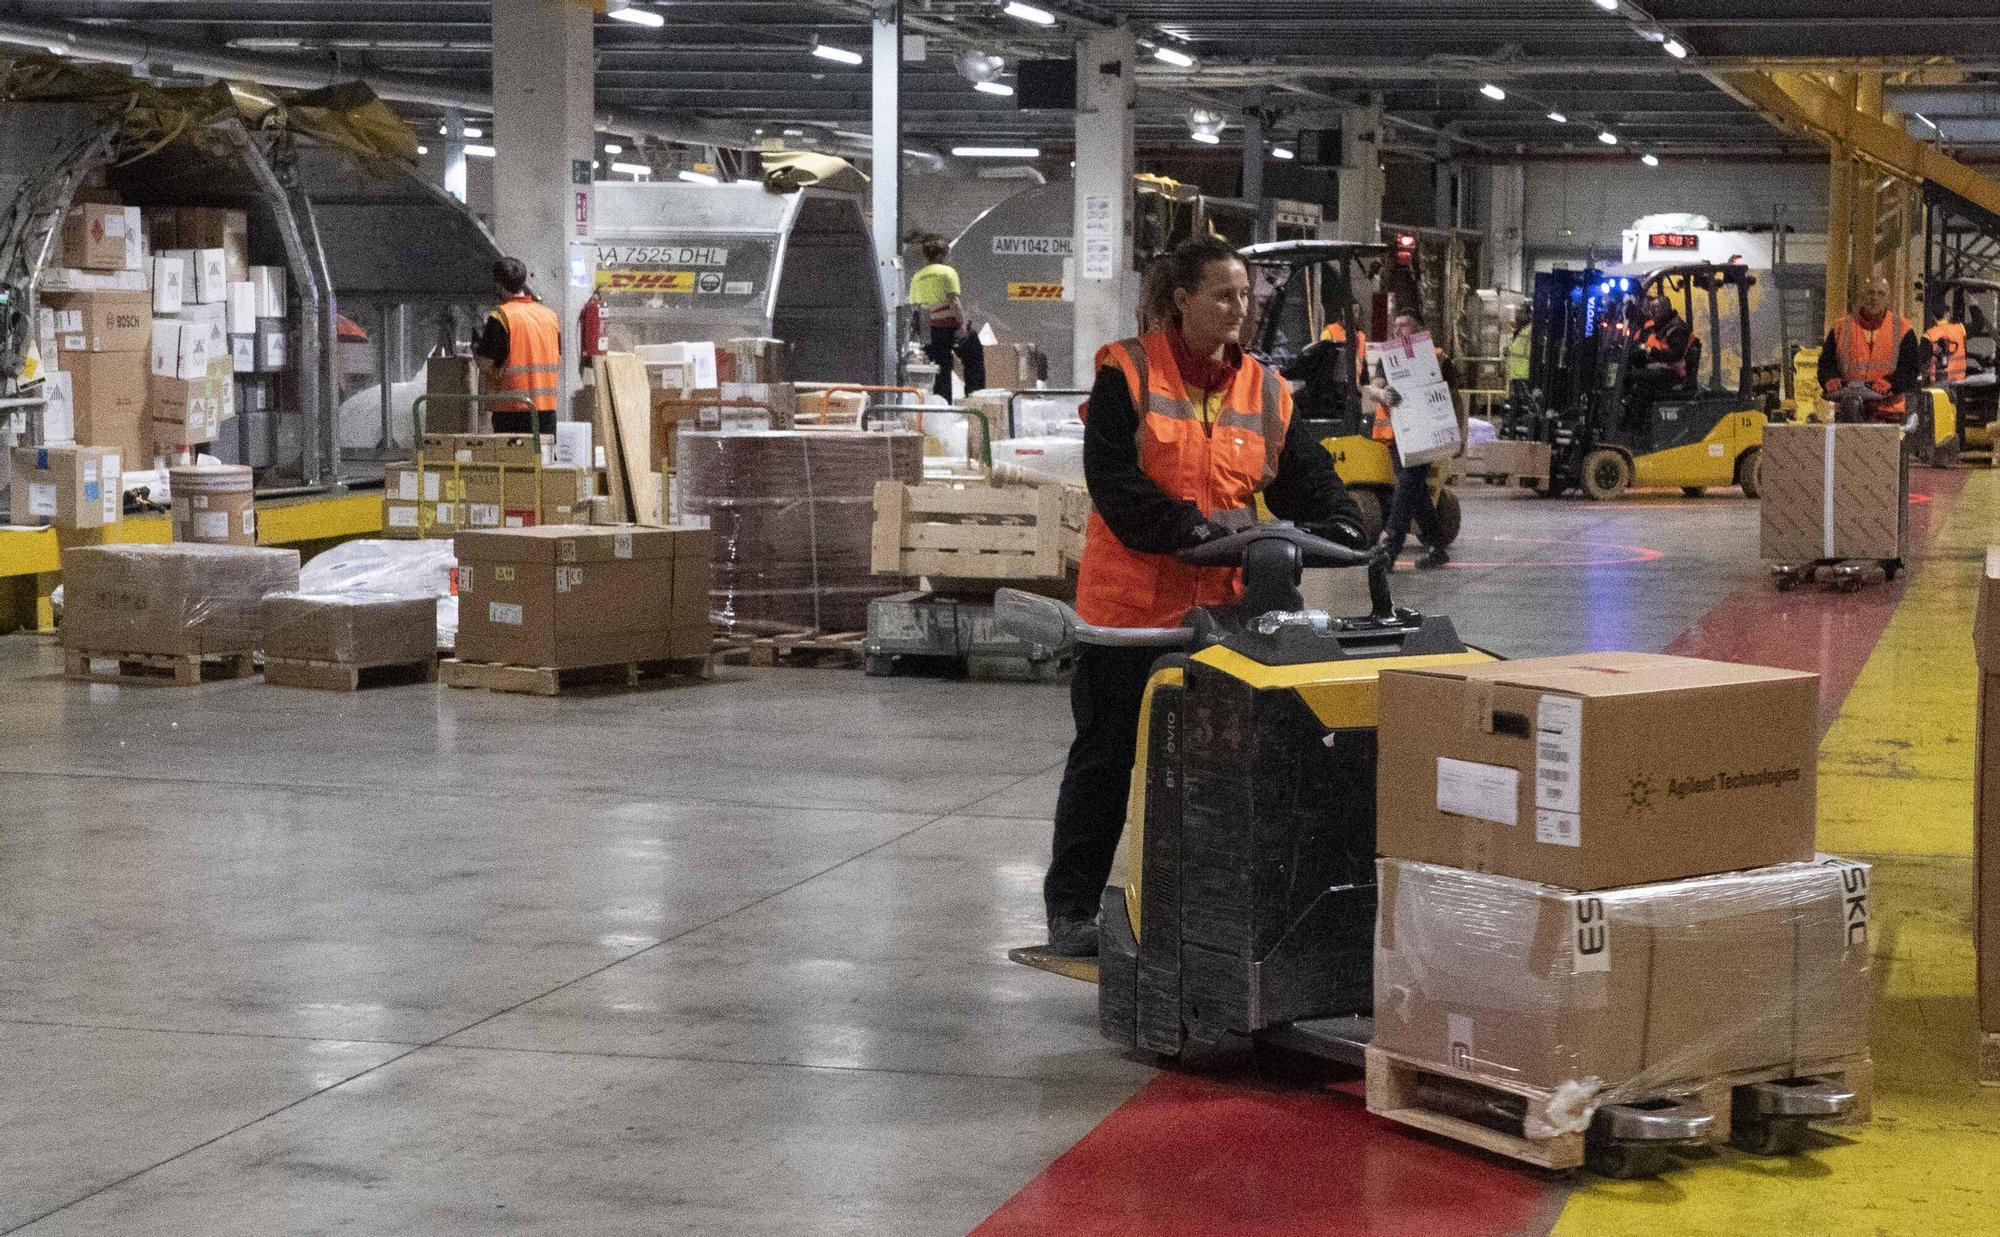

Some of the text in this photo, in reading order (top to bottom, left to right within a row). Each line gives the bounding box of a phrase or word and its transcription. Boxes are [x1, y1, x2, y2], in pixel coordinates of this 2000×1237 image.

[625, 248, 672, 262] 7525
[679, 248, 722, 264] DHL
[611, 274, 678, 288] DHL
[117, 315, 140, 328] BOSCH
[1585, 297, 1596, 338] TOYOTA
[1668, 768, 1800, 800] Agilent Technologies
